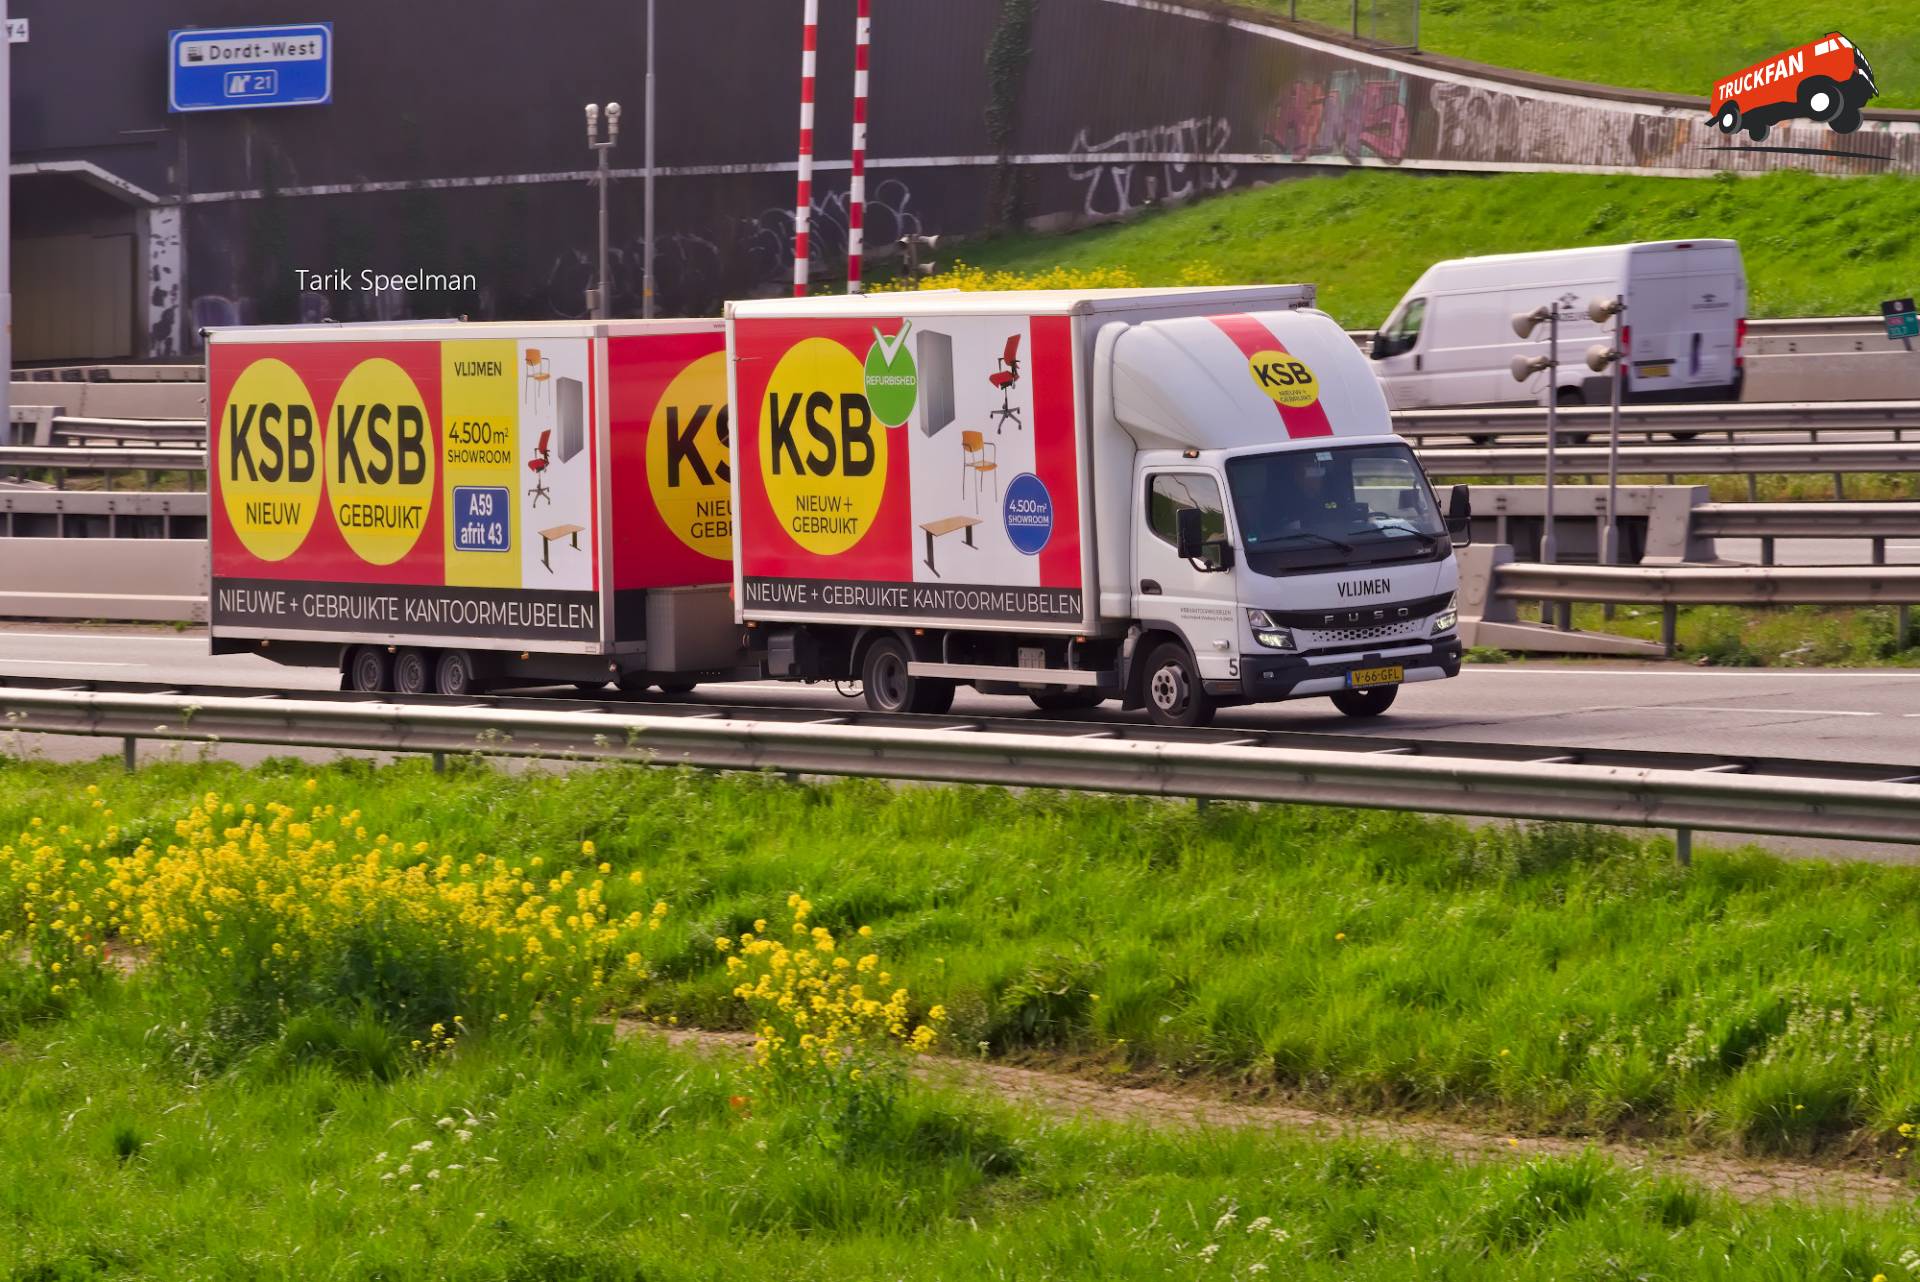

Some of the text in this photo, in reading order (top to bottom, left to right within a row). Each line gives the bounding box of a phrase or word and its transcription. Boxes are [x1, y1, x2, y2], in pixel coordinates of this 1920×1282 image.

[209, 41, 316, 60] Dordt-West
[253, 76, 273, 91] 21
[454, 362, 502, 377] VLIJMEN
[1253, 362, 1313, 387] KSB
[866, 376, 916, 386] REFURBISHED
[230, 402, 315, 483] KSB
[449, 422, 492, 444] 4.500
[769, 391, 875, 477] KSB
[337, 403, 426, 485] KSB
[448, 450, 511, 464] SHOWROOM
[469, 493, 493, 516] A59
[796, 495, 842, 512] NIEUW
[1009, 499, 1037, 513] 4.500
[246, 502, 301, 525] NIEUW
[339, 503, 422, 529] GEBRUIKT
[1008, 514, 1049, 524] SHOWROOM
[461, 523, 503, 545] afrit 43
[690, 521, 733, 538] GEB
[792, 516, 858, 534] GEBRUIKT
[1337, 578, 1391, 598] VLIJMEN
[746, 583, 1081, 614] NIEUWE + GEBRUIKTE KANTOORMEUBELEN
[219, 589, 594, 629] NIEUWE + GEBRUIKTE KANTOORMEUBELEN
[1324, 607, 1408, 624] FUSO
[1229, 659, 1238, 676] 5
[1354, 668, 1400, 683] V-66-GFL
